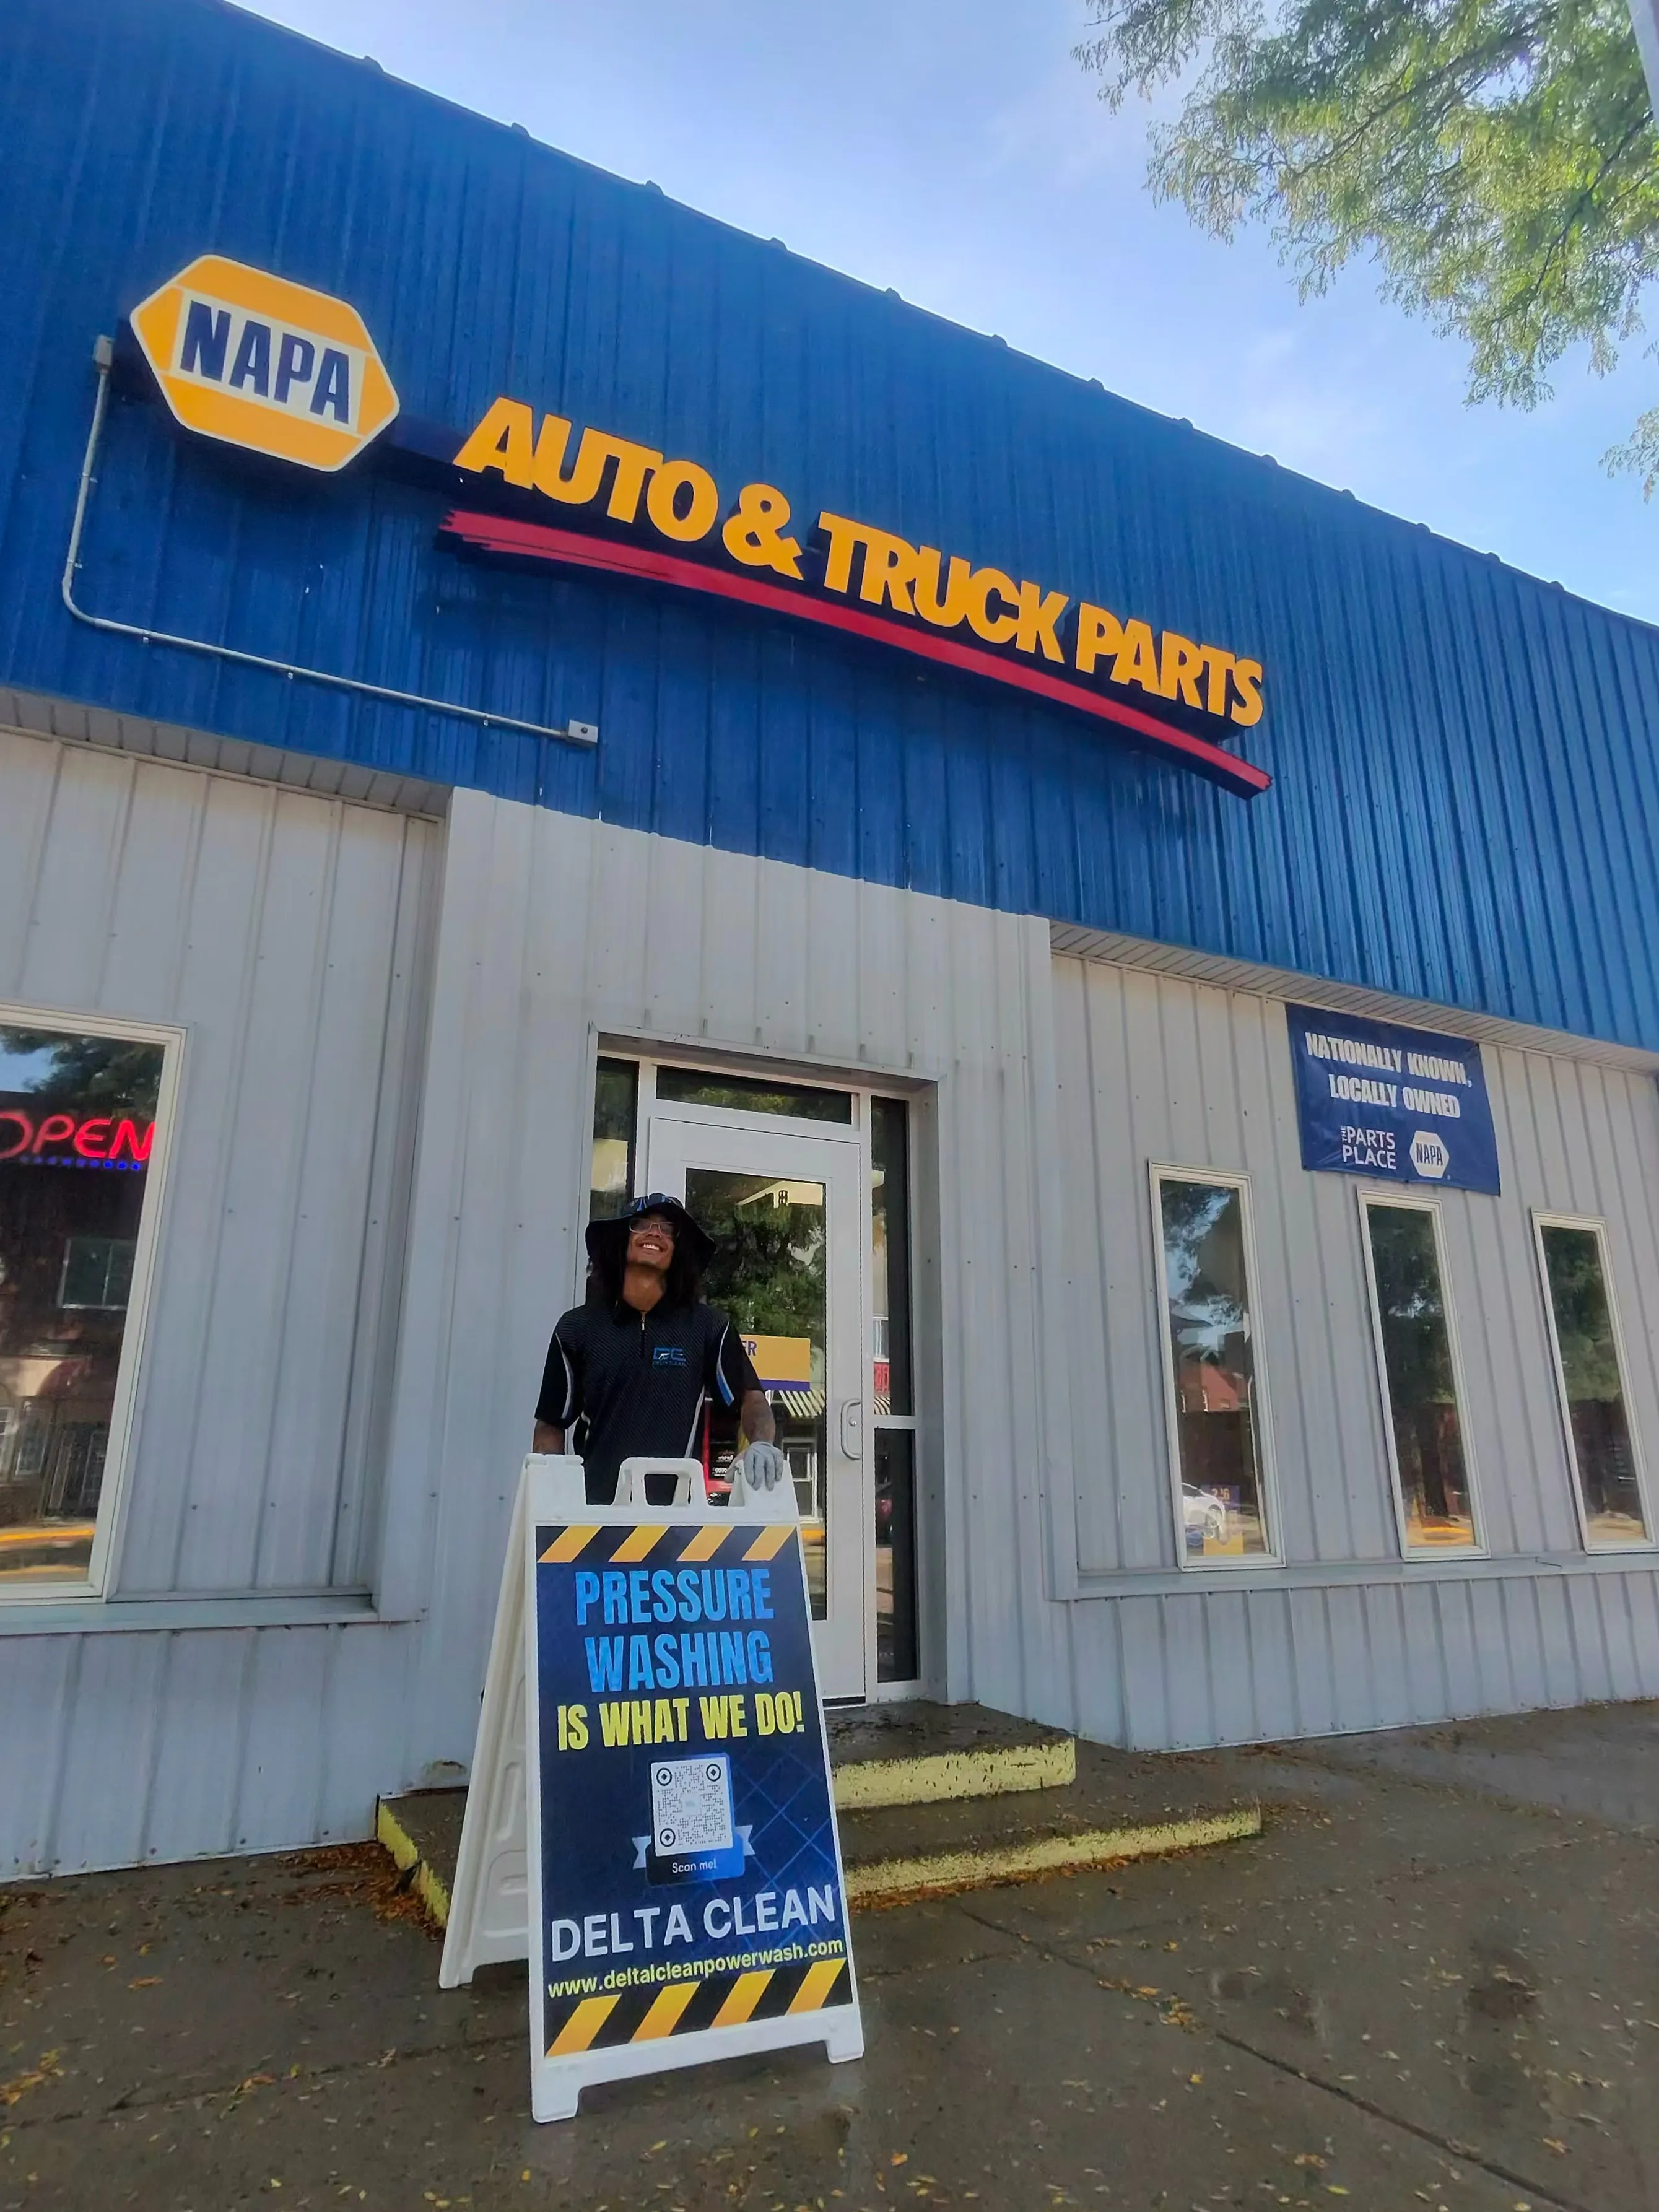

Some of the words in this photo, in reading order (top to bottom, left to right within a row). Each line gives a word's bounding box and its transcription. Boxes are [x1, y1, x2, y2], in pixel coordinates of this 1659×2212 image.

[180, 300, 349, 425] NAPA
[452, 396, 718, 542] AUTO
[722, 483, 804, 580] &
[818, 511, 1069, 663] TRUCK
[1076, 602, 1263, 727] PARTS
[1305, 1032, 1402, 1073] NATIONALLY
[1328, 1074, 1397, 1108] LOCALLY
[1402, 1087, 1461, 1118] OWNED
[1342, 1144, 1397, 1170] PLACE
[1346, 1126, 1396, 1150] PARTS
[1416, 1142, 1443, 1166] NAPA
[575, 1568, 775, 1626] PRESSURE
[584, 1629, 773, 1693] WASHING
[557, 1704, 588, 1751] IS
[598, 1697, 690, 1748] WHAT
[699, 1694, 747, 1740] WE
[754, 1691, 805, 1736] DO!
[671, 1861, 697, 1874] Scan
[699, 1857, 717, 1871] me!
[551, 1904, 693, 1962] DELTA
[703, 1884, 835, 1939] CLEAN
